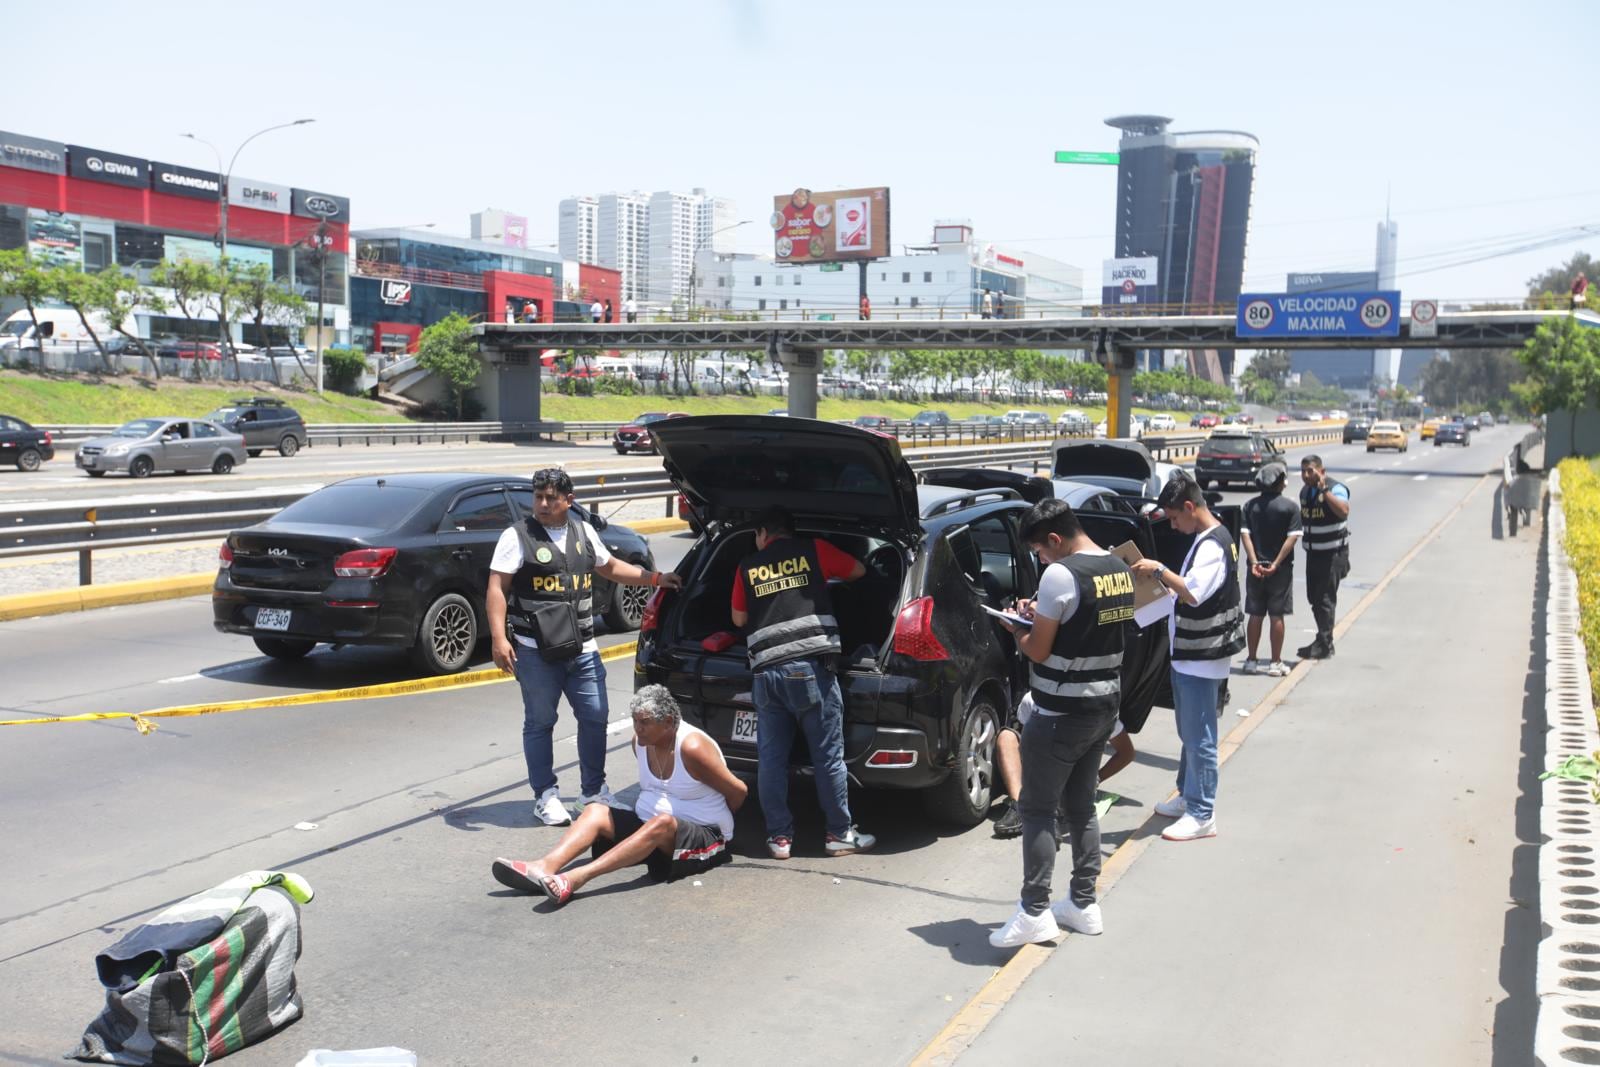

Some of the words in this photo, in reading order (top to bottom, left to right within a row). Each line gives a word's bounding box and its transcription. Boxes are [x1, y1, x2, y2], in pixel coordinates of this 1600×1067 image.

[104, 161, 138, 177] GWM
[161, 173, 219, 192] CHANGAN
[243, 187, 278, 202] DFSK
[1111, 269, 1146, 281] HACIENDO
[1294, 275, 1323, 285] BBVA
[1279, 297, 1357, 313] VELOCIDAD
[1365, 304, 1387, 318] 80
[1249, 306, 1270, 320] 80
[1287, 316, 1346, 331] MAXIMA
[268, 547, 288, 556] KIA
[748, 555, 811, 586] POLICIA
[1092, 571, 1134, 598] POLICIA
[257, 613, 289, 627] CCF-349
